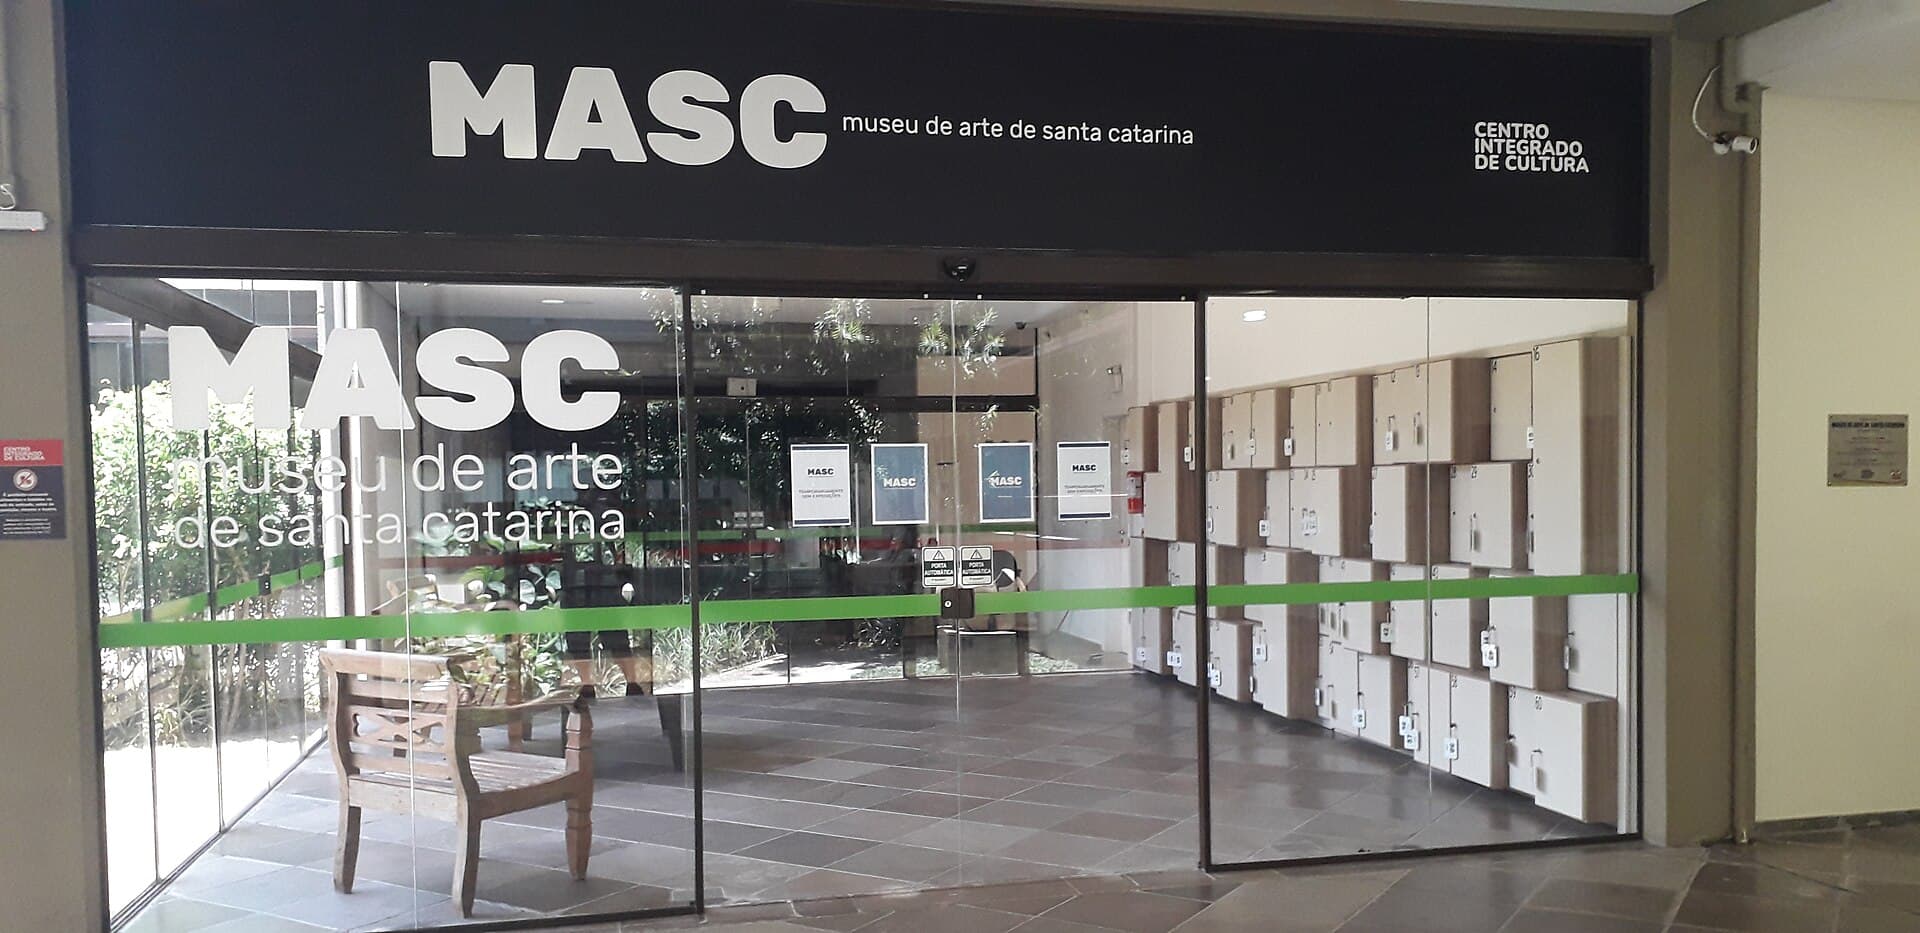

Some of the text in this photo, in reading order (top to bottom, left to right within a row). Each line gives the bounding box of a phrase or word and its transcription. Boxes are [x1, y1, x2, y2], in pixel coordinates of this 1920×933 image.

[429, 61, 827, 168] MASC
[842, 115, 1194, 144] museu de arte de santa catarina
[1474, 122, 1550, 139] CENTRO
[1474, 138, 1583, 157] INTEGRADO
[1474, 154, 1590, 173] DE CULTURA
[168, 326, 620, 431] MASC
[173, 443, 623, 495] museu de arte
[807, 468, 834, 476] MASC
[1072, 464, 1097, 472] MASC
[883, 478, 916, 487] MASC
[991, 476, 1022, 486] MASC
[174, 500, 625, 548] de santa catarina
